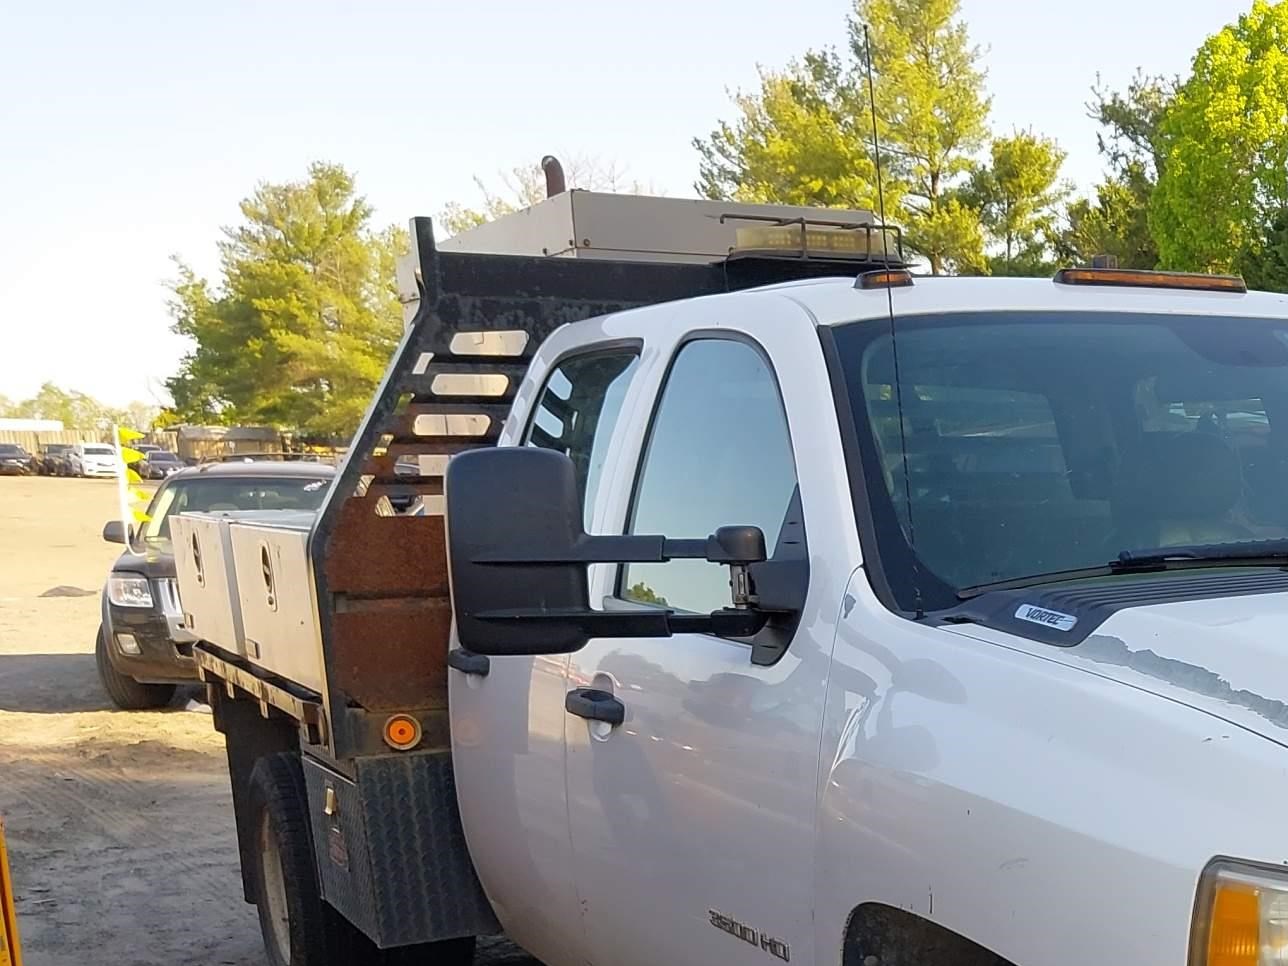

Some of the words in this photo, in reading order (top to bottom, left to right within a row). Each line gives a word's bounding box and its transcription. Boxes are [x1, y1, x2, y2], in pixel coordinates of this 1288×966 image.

[1025, 607, 1066, 625] VORTEC
[708, 908, 758, 947] 3500
[760, 932, 790, 962] HD
